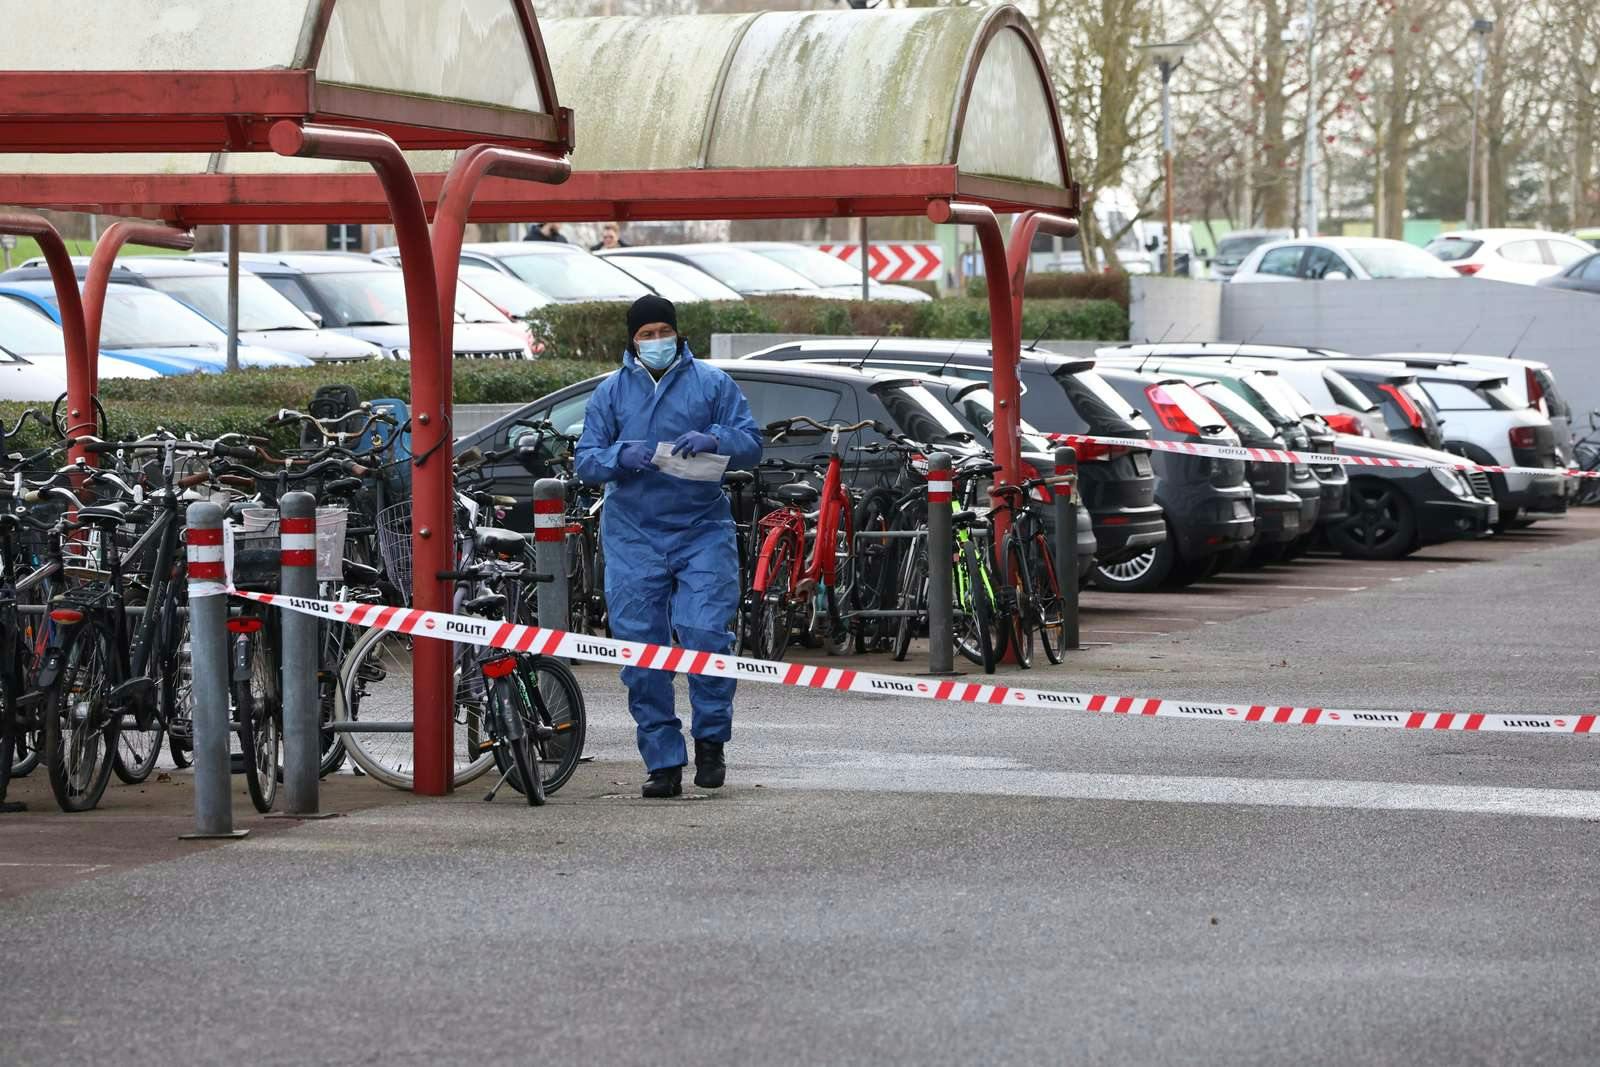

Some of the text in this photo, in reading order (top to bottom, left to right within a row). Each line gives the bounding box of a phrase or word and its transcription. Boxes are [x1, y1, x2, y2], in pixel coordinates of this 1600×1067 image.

[290, 598, 329, 613] POLITI
[446, 620, 486, 636] POLITI
[577, 643, 617, 658] POLITI
[736, 661, 778, 675] POLITI
[871, 680, 914, 692] POLITI
[1037, 693, 1081, 704] POLITI
[1178, 705, 1223, 716] POLITI
[1352, 713, 1399, 722] POLITI
[1503, 719, 1551, 728] POLITI
